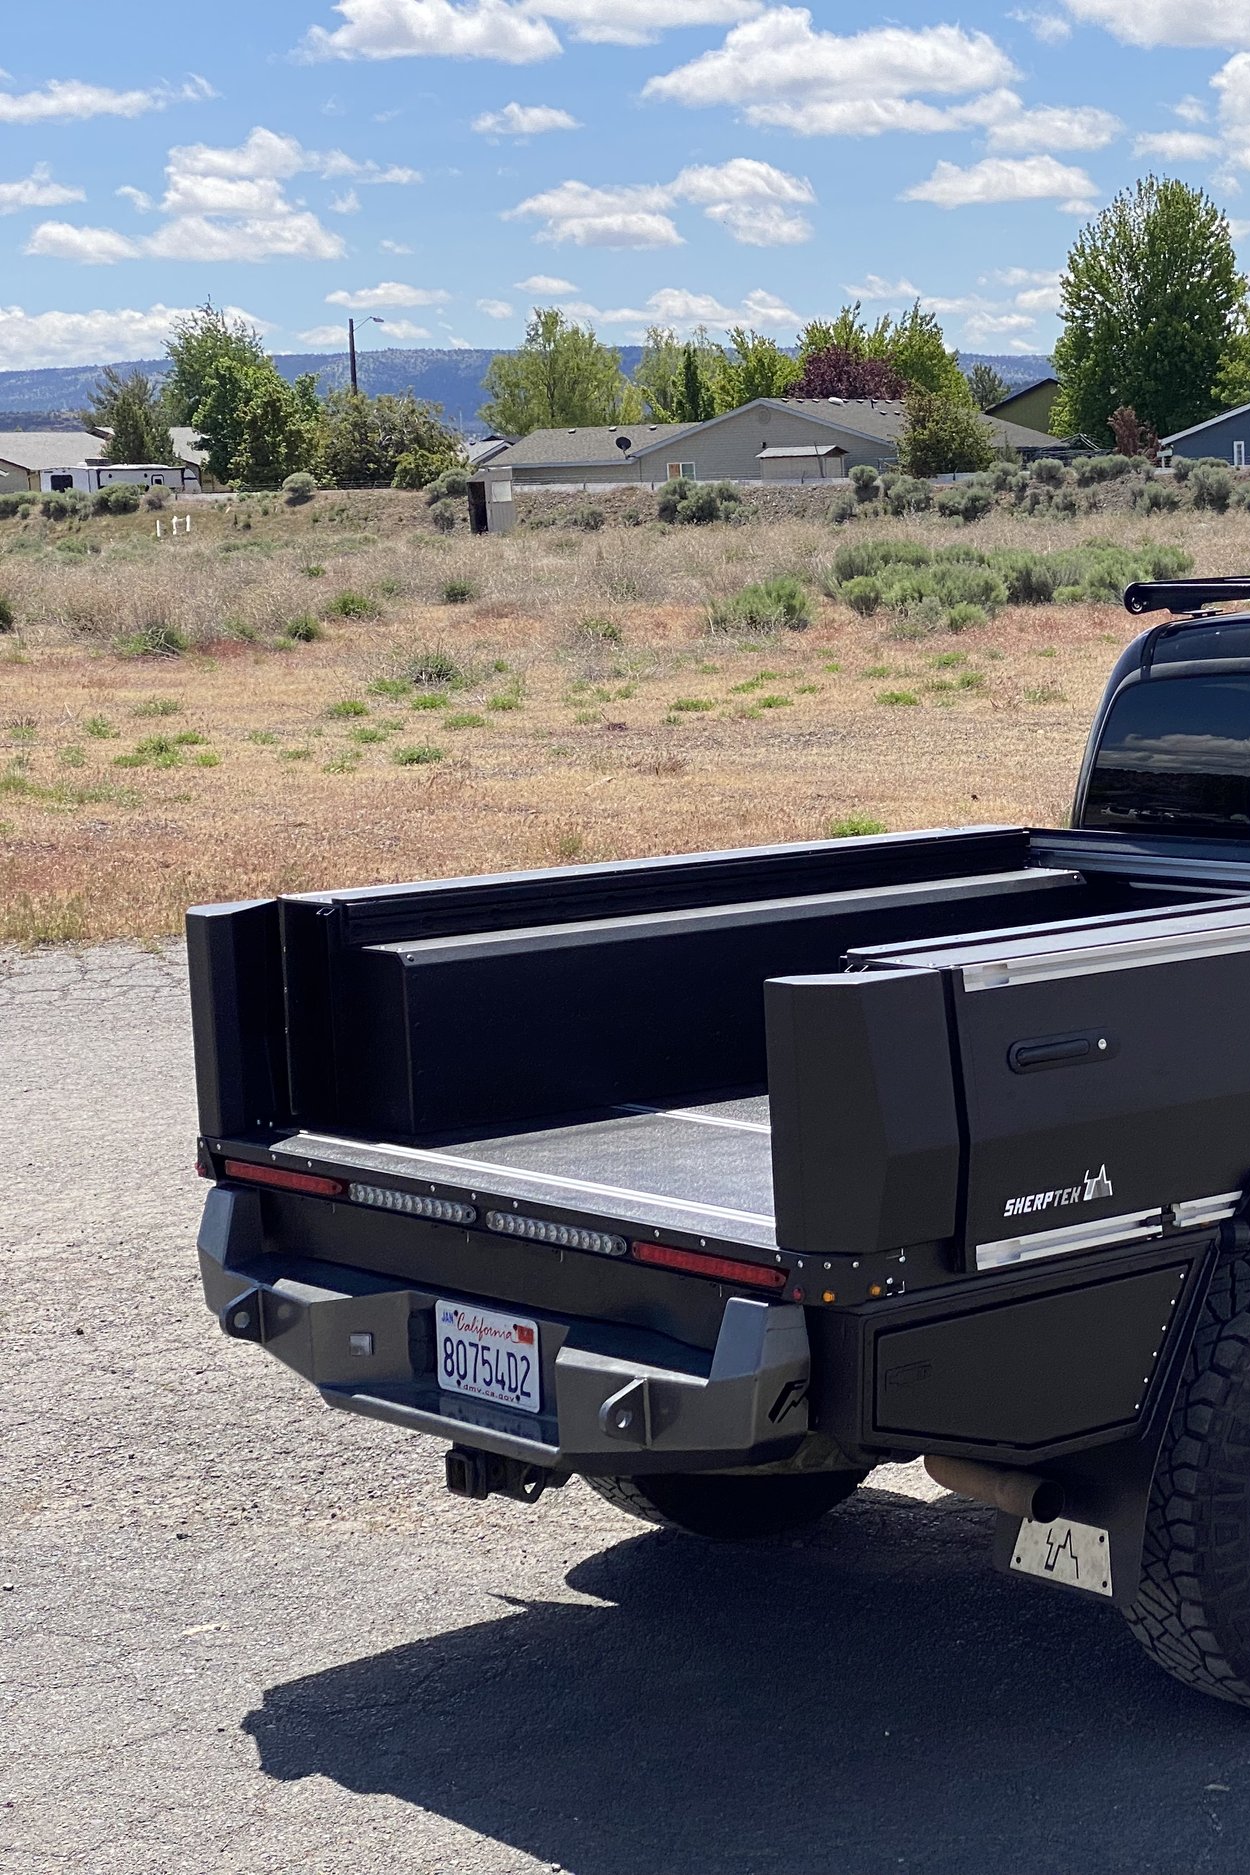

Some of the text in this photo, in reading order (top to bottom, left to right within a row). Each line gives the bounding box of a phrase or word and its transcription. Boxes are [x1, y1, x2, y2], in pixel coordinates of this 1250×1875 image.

[1003, 1186, 1081, 1217] SHERPTEK
[442, 1311, 454, 1323] JAN
[457, 1312, 516, 1342] California
[443, 1336, 531, 1398] 80754D2
[463, 1384, 515, 1402] dmv.ca.gov
